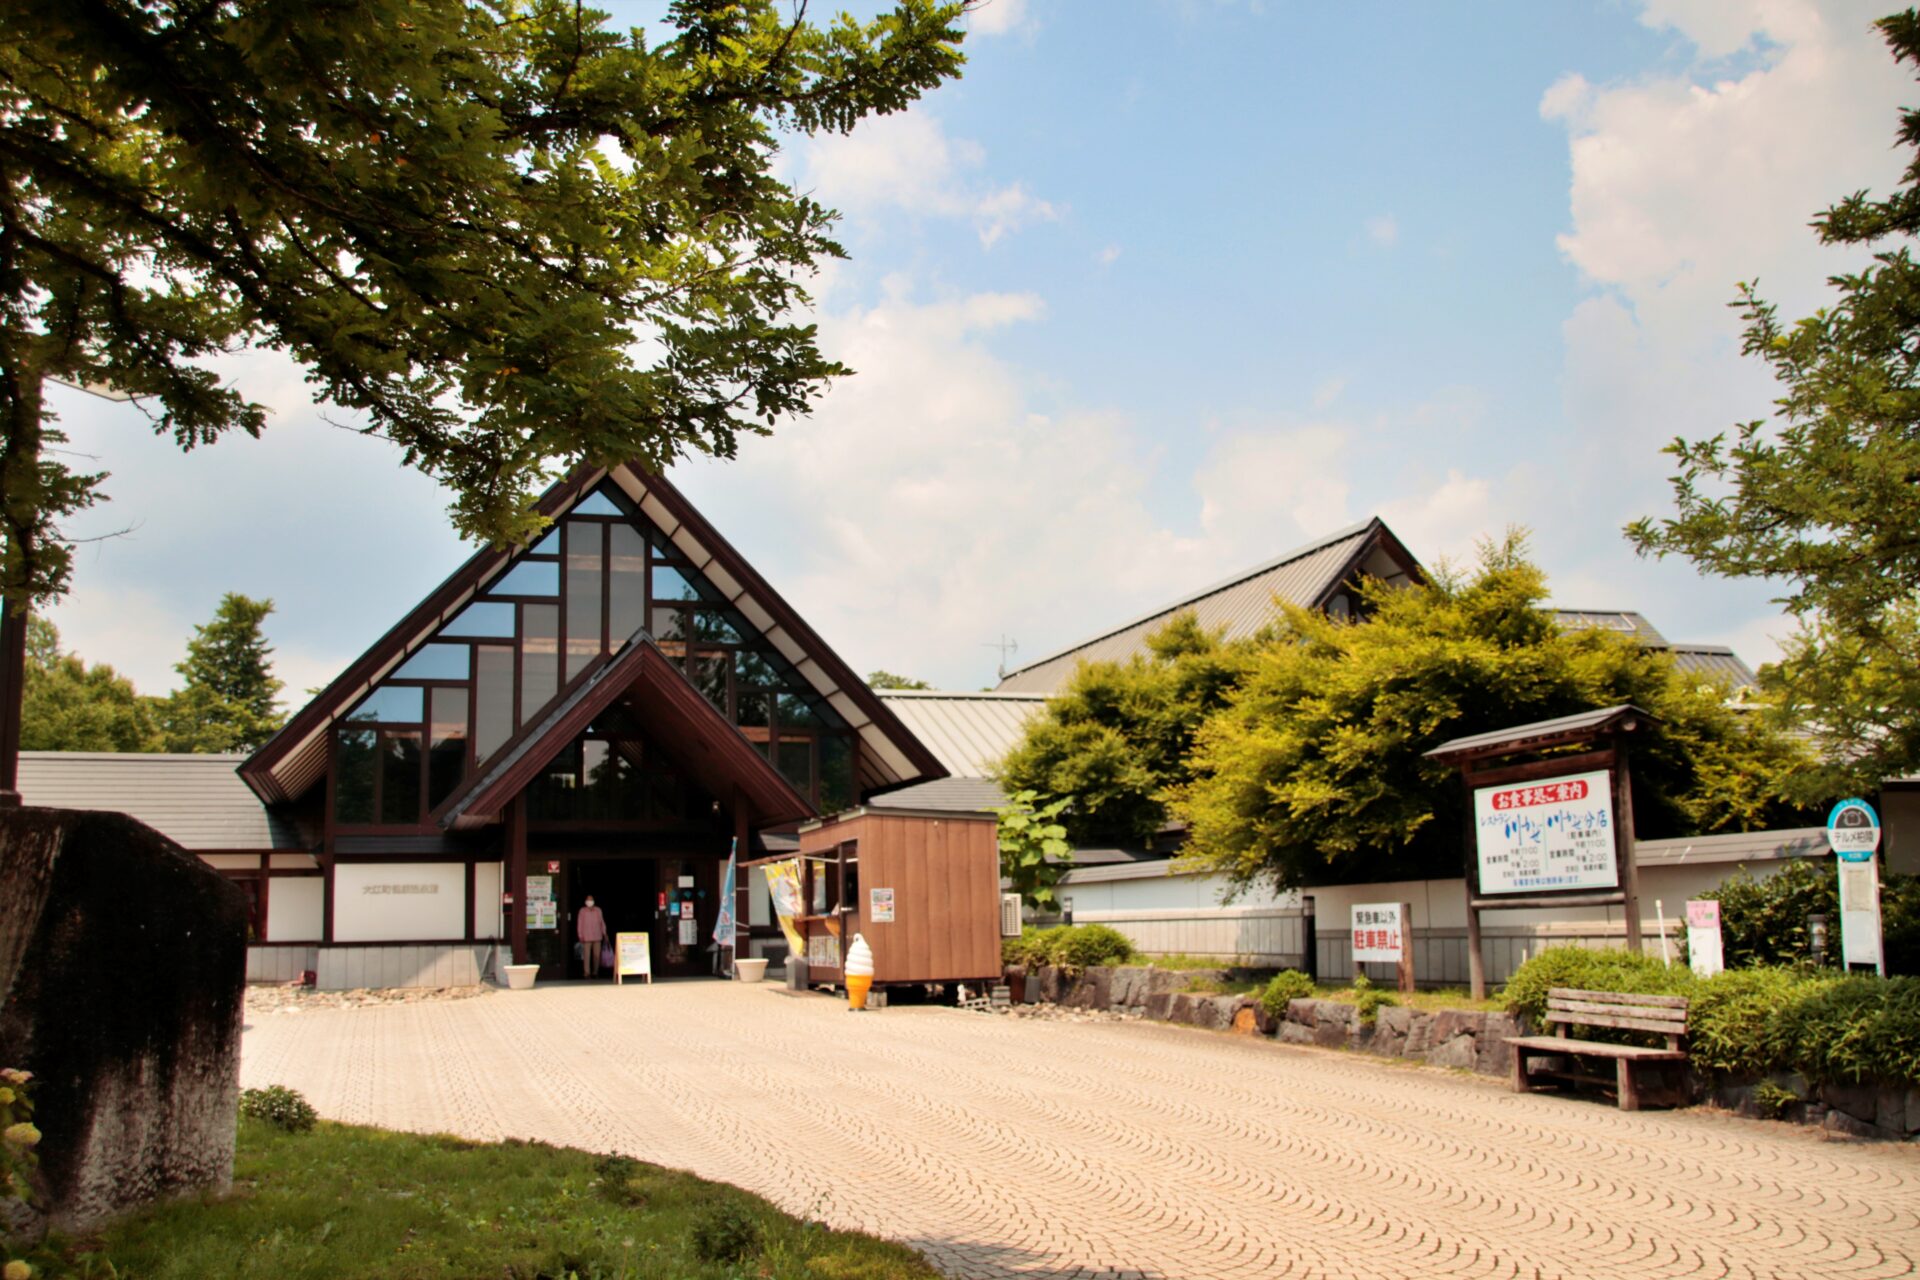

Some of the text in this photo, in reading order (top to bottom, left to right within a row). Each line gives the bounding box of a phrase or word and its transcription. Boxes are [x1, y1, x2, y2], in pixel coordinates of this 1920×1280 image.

[1498, 782, 1583, 808] お食事処ご案内
[1480, 812, 1511, 827] レストラン
[1355, 910, 1396, 925] 緊急車以外
[1353, 929, 1400, 950] 駐車禁止
